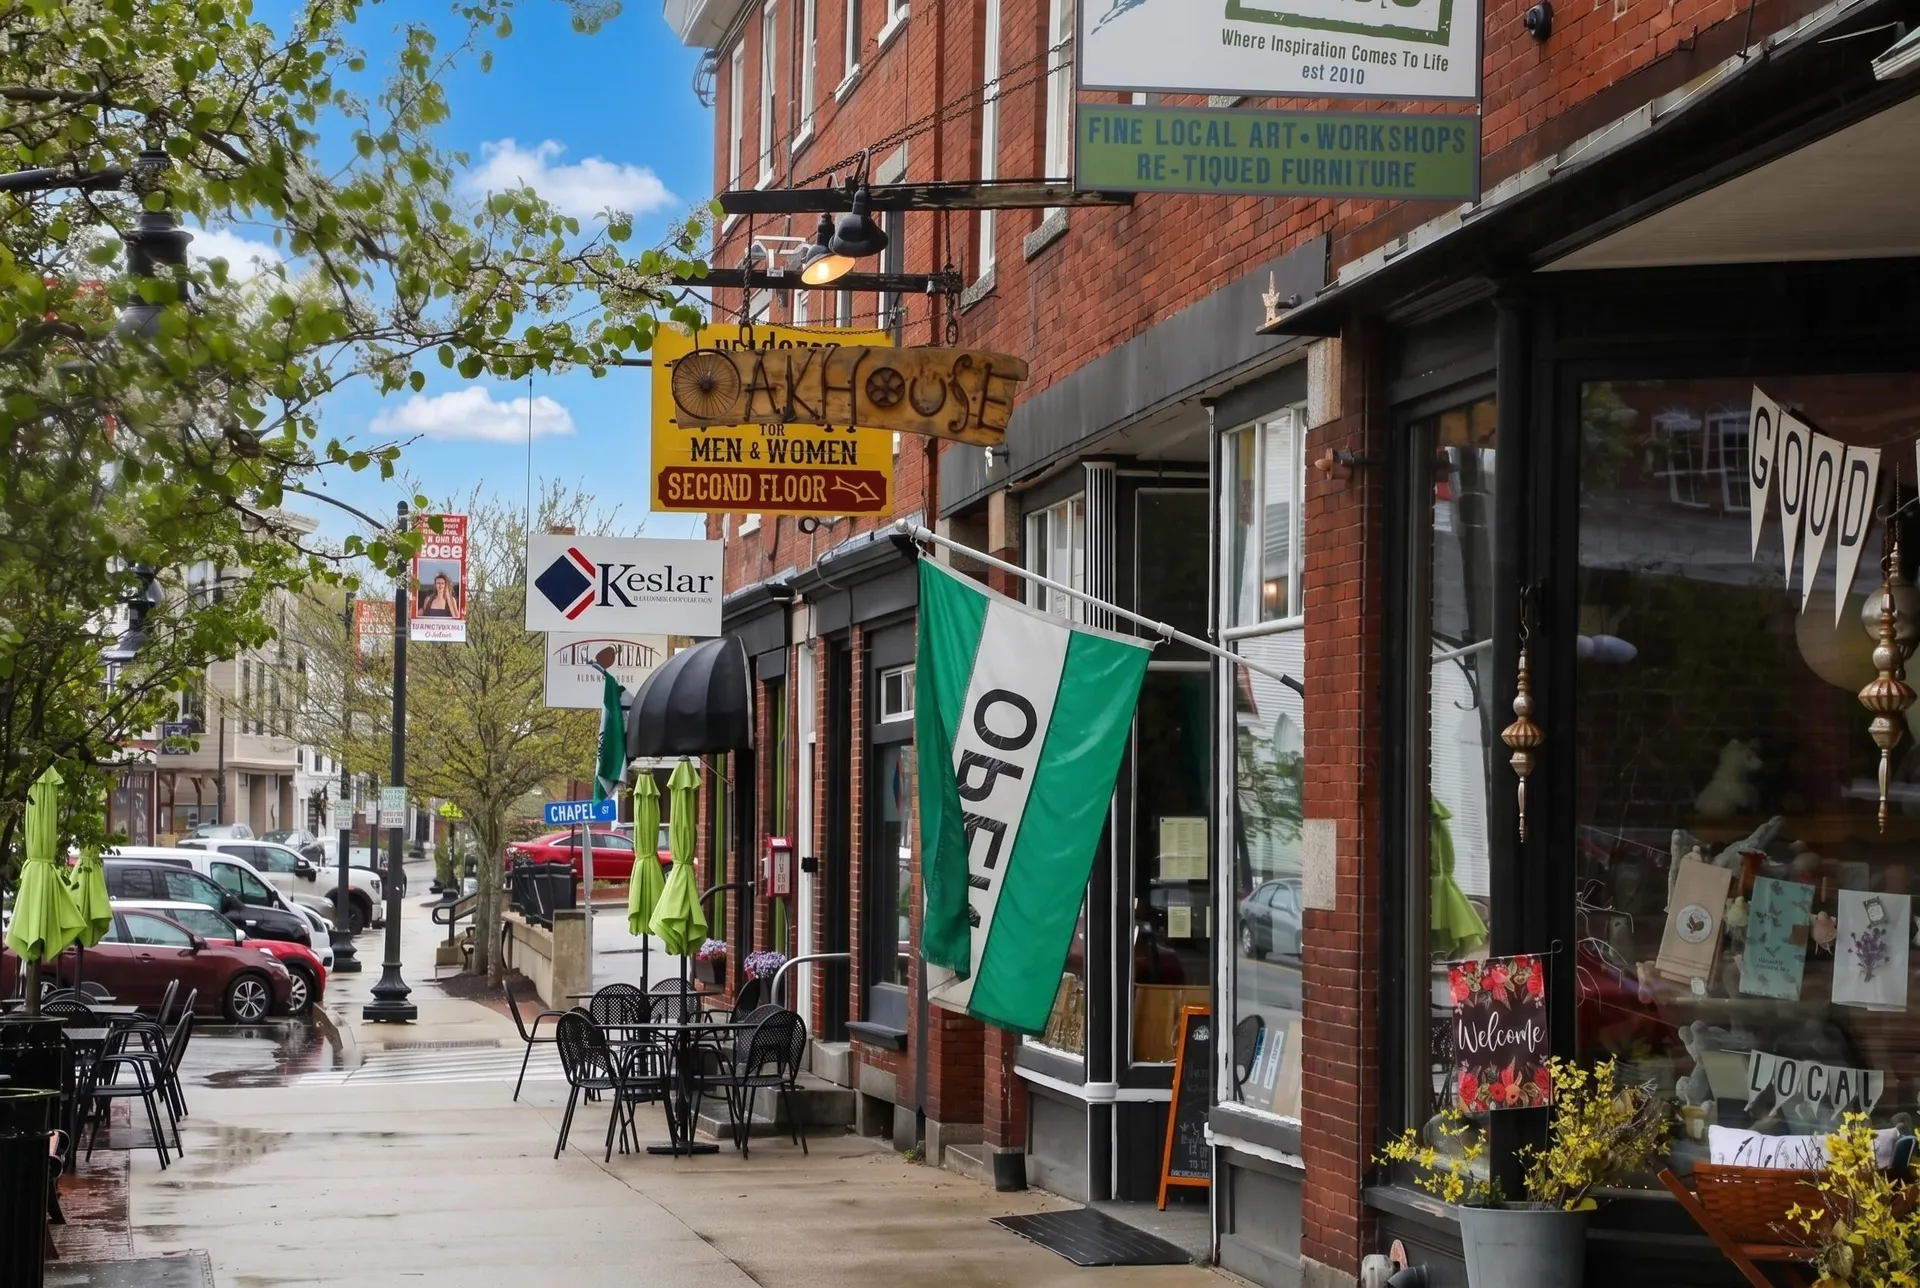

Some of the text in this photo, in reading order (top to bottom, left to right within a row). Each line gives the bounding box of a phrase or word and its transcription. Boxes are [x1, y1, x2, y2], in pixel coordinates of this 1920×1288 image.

[1221, 28, 1449, 72] Where Inspiration Comes To Life
[1302, 64, 1365, 85] est 2010
[1088, 116, 1143, 145] FINE
[1155, 120, 1237, 148] LOCAL
[1137, 153, 1416, 189] RE-TIQUED FURNITURE
[690, 437, 858, 465] MEN & WOMEN
[668, 472, 827, 504] SECOND FLOOR
[1752, 406, 1869, 547] GOOD
[595, 563, 714, 608] Keslar
[550, 803, 596, 822] CHAPEL
[1458, 1011, 1546, 1053] Welcome
[1751, 1053, 1872, 1108] LOCAL
